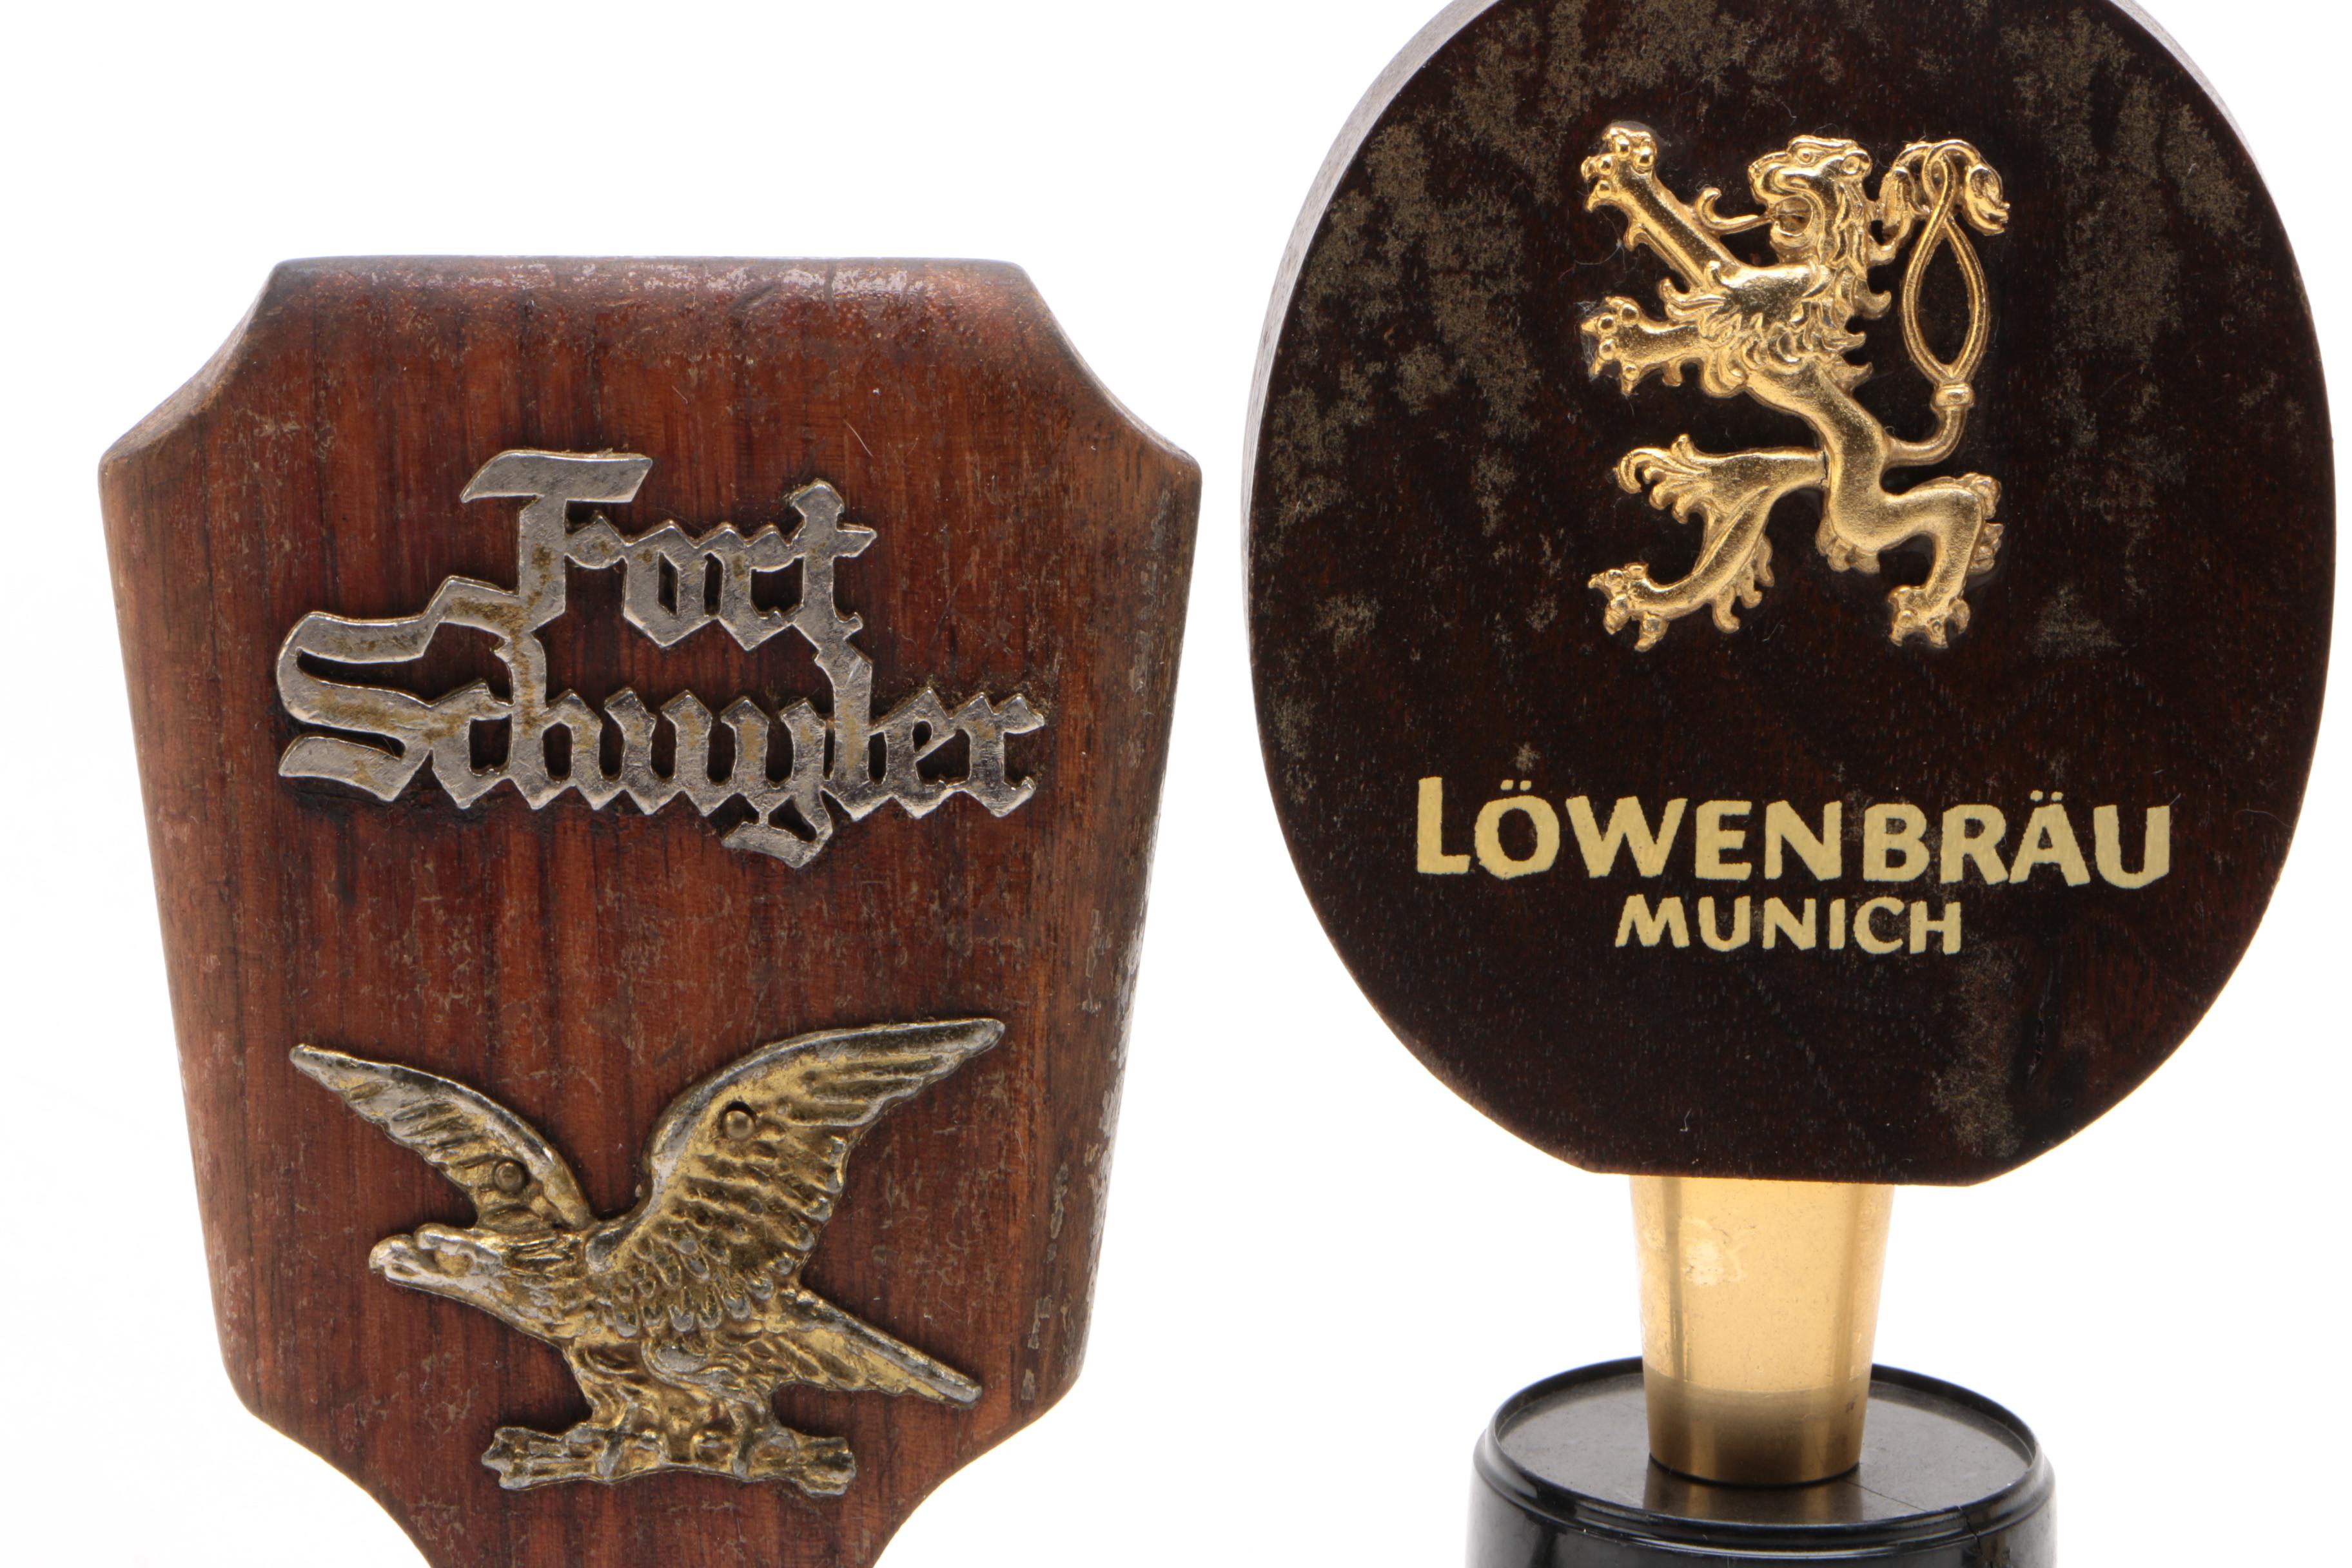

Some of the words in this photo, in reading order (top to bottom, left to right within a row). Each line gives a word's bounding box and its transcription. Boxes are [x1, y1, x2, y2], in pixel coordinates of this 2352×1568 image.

[460, 449, 877, 651] Fort
[276, 575, 1046, 869] Schuyler
[1417, 776, 2170, 889] LÖWENBRÄU
[1615, 894, 1961, 954] MUNICH
